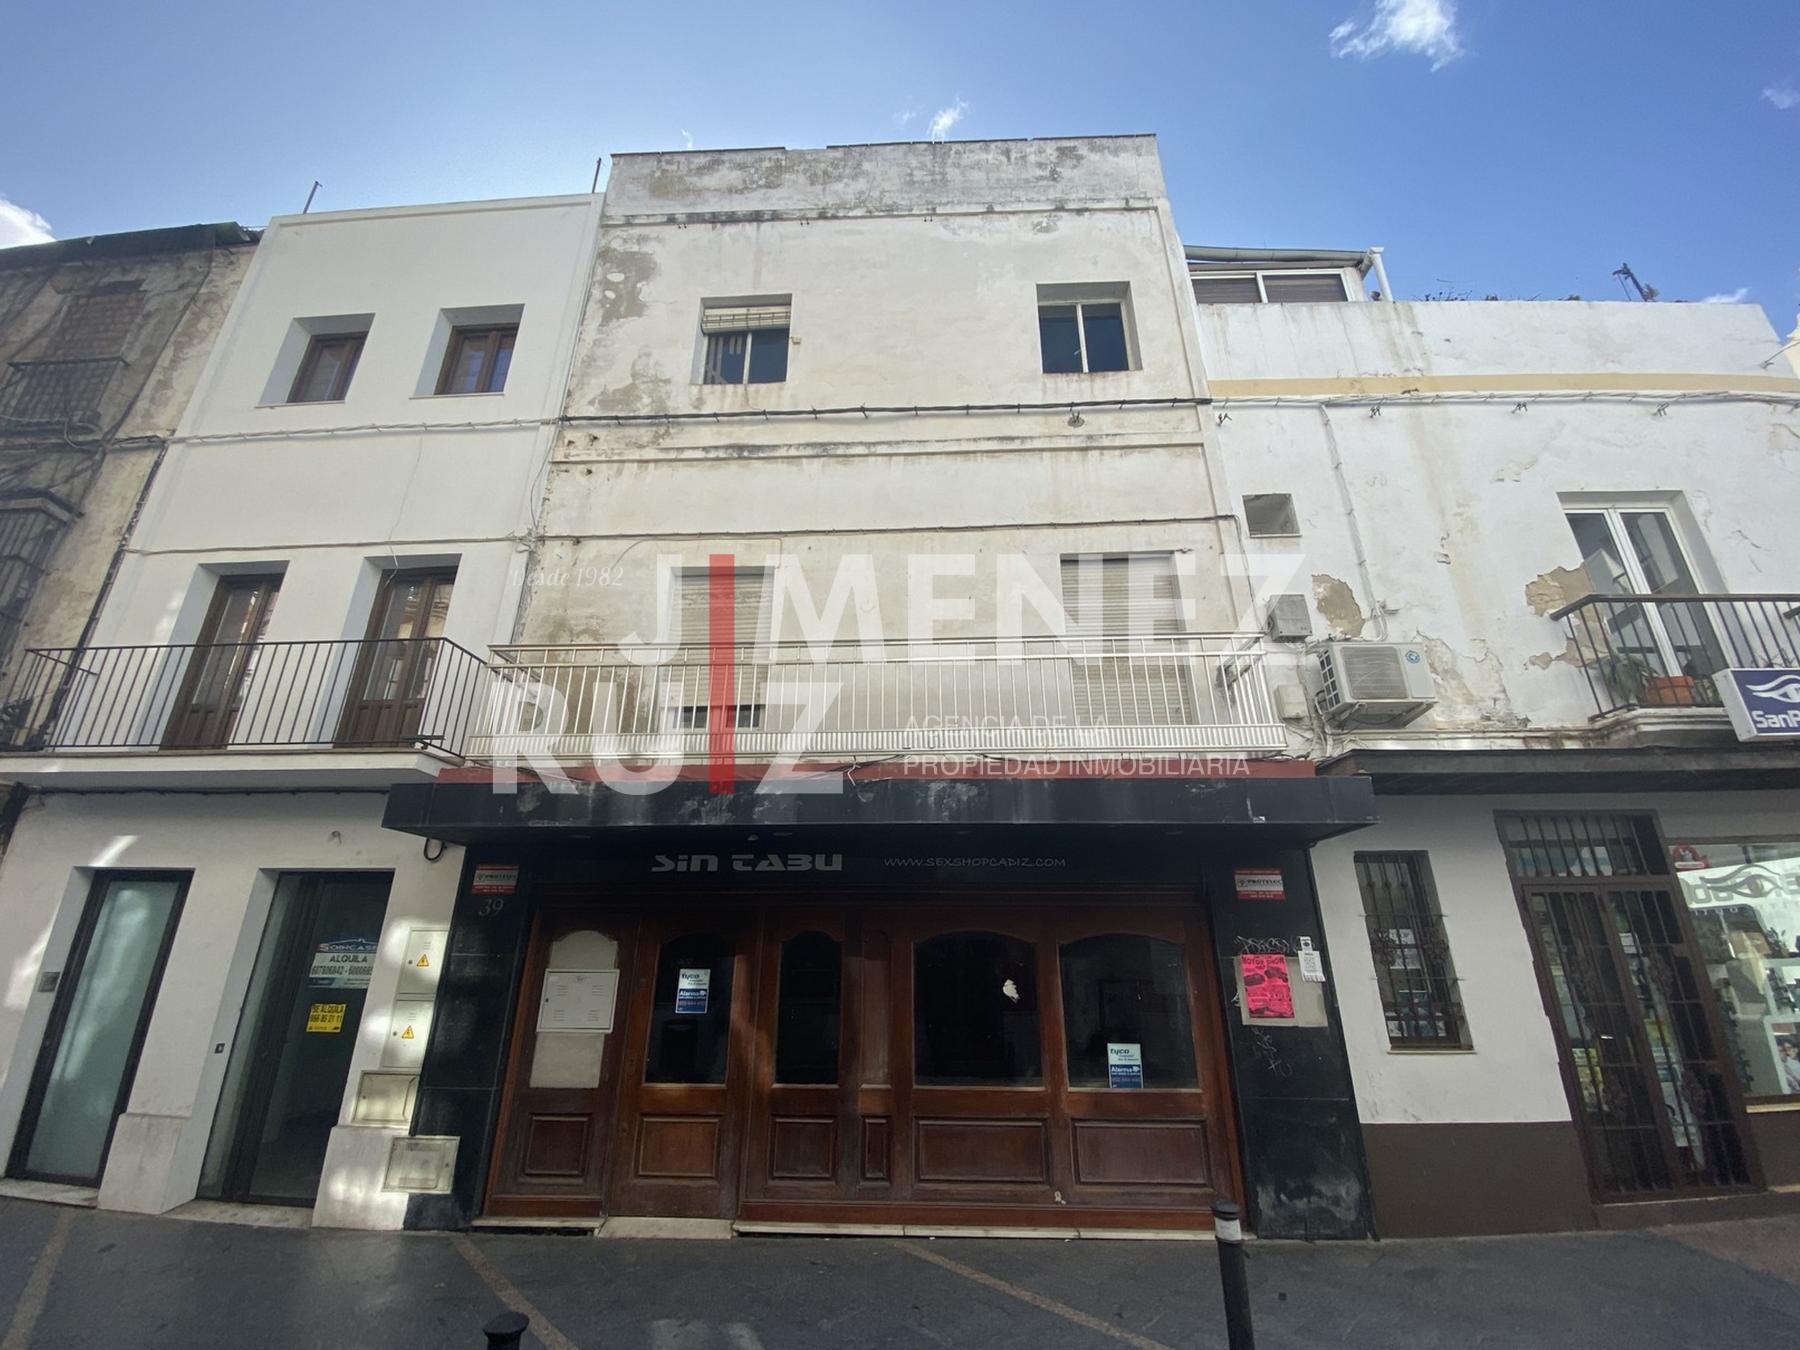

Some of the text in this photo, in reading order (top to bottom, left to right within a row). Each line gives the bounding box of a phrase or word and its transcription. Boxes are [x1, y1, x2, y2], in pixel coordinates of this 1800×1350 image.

[884, 857, 1067, 867] WWW.SEXSHOPCADIZ.COM
[479, 898, 504, 917] 39
[329, 955, 368, 963] ALQUILA
